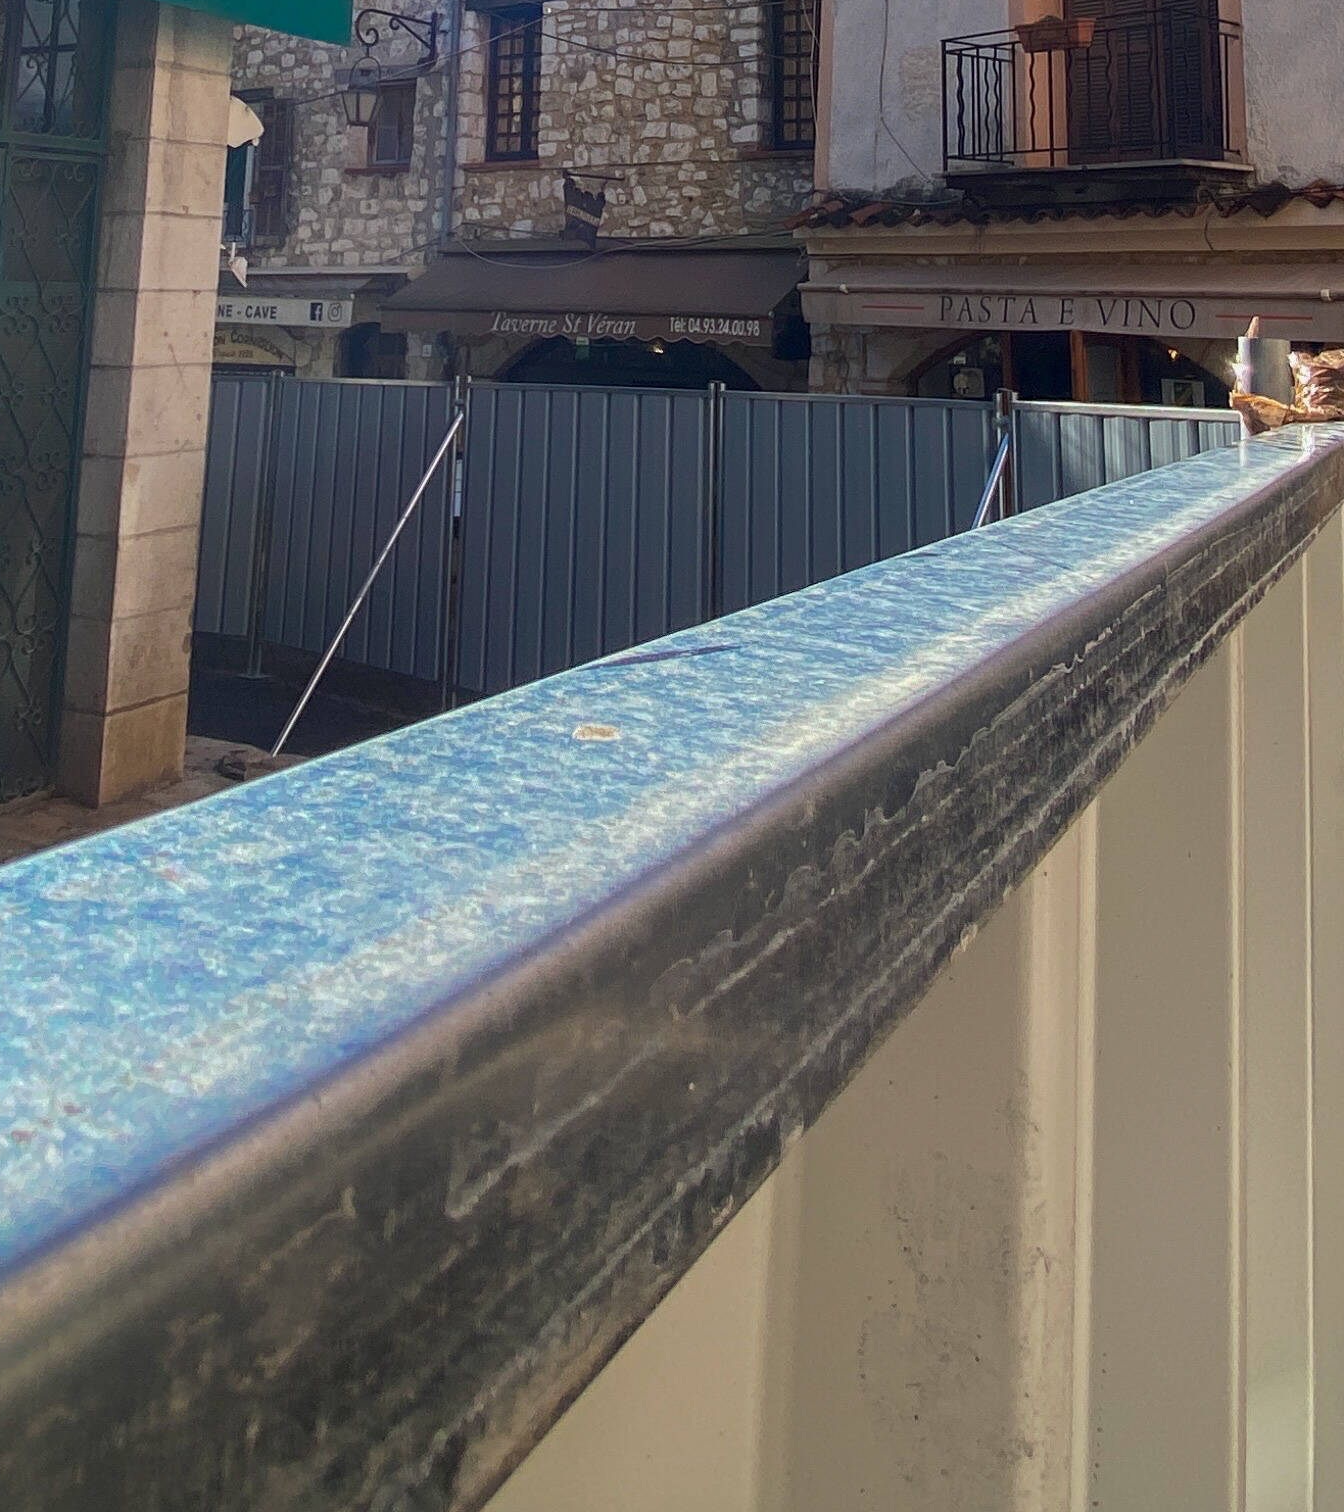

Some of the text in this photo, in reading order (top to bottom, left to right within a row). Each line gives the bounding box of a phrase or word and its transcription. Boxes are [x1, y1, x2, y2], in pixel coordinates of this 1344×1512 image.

[245, 305, 278, 320] CAVE
[490, 311, 637, 336] Taverne St Véran
[939, 295, 1196, 330] PASTA E VINO
